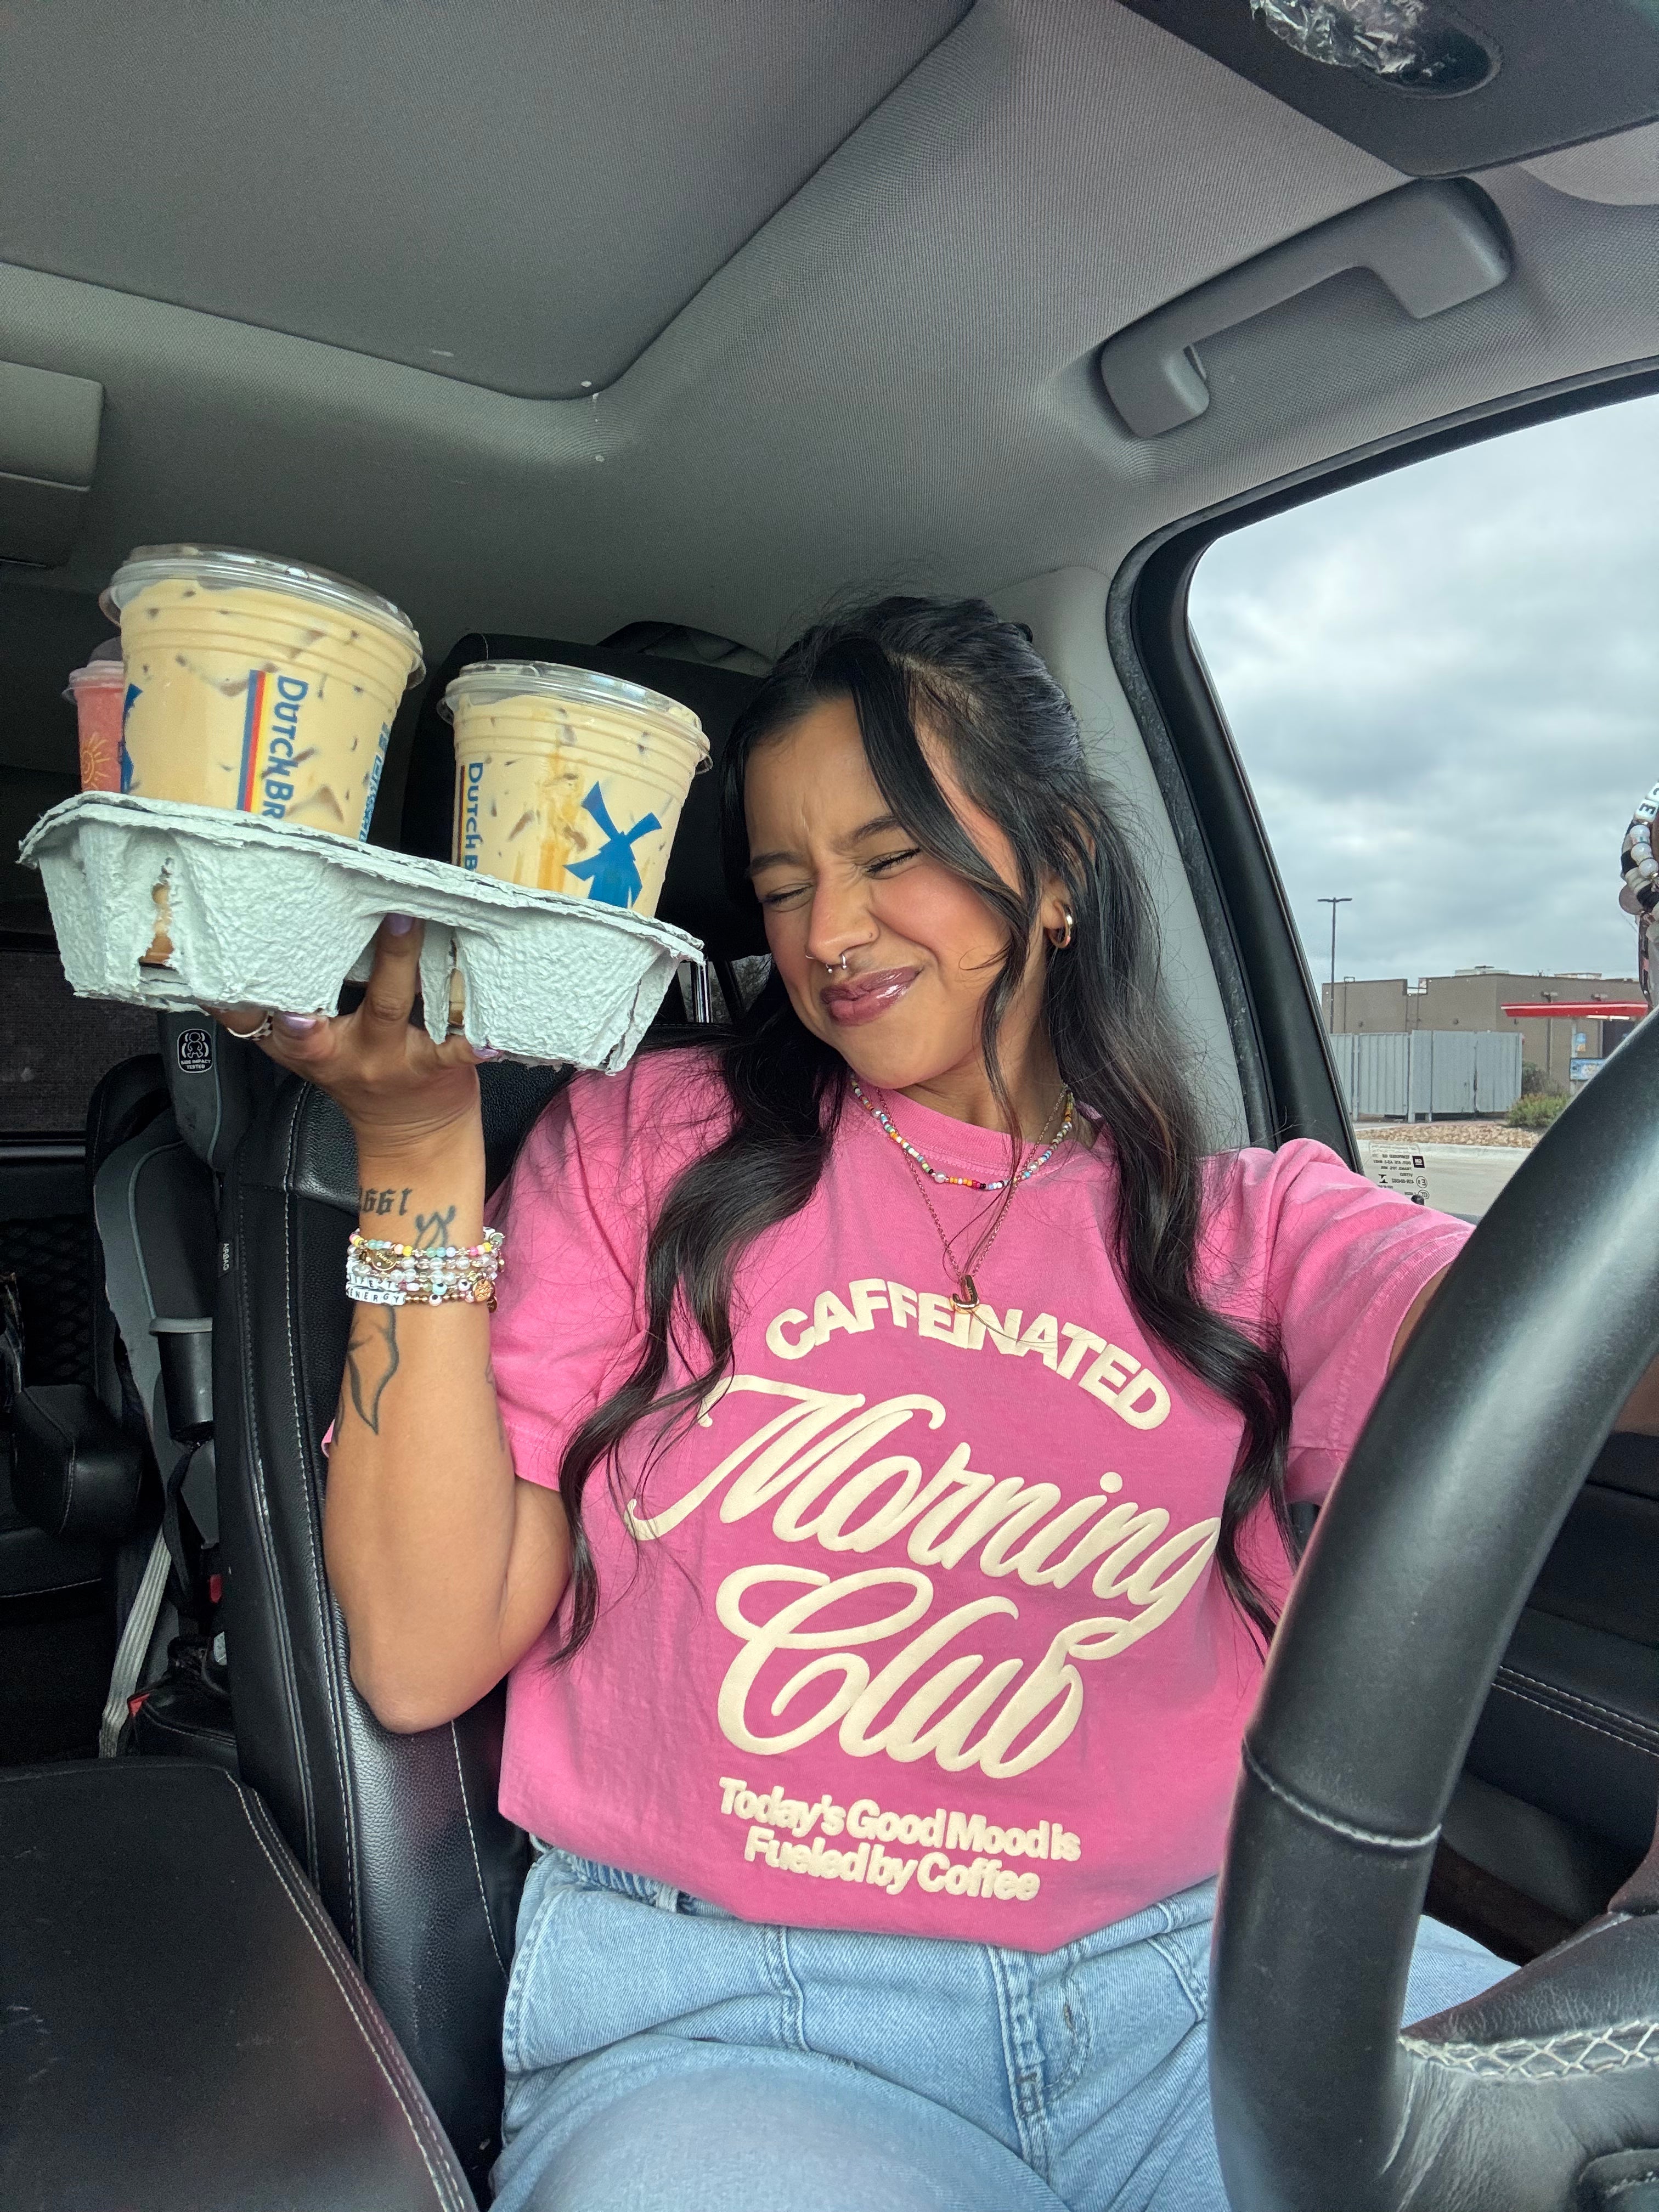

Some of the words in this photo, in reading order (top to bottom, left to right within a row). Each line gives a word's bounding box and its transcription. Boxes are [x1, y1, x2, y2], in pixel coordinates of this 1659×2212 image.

[268, 675, 309, 777] DUTCH
[465, 763, 484, 849] DUTCH
[349, 1287, 399, 1303] ENERGY
[766, 1277, 1172, 1430] CAFFEINATED
[624, 1374, 1222, 1647] Morning
[715, 1564, 1087, 1779] Club
[719, 1776, 847, 1838] Today's
[845, 1798, 947, 1849] Good
[945, 1811, 1051, 1860] Mood
[1050, 1822, 1082, 1862] Is
[743, 1825, 871, 1883] Fueled
[866, 1843, 919, 1896] by
[916, 1851, 1041, 1901] Coffee
